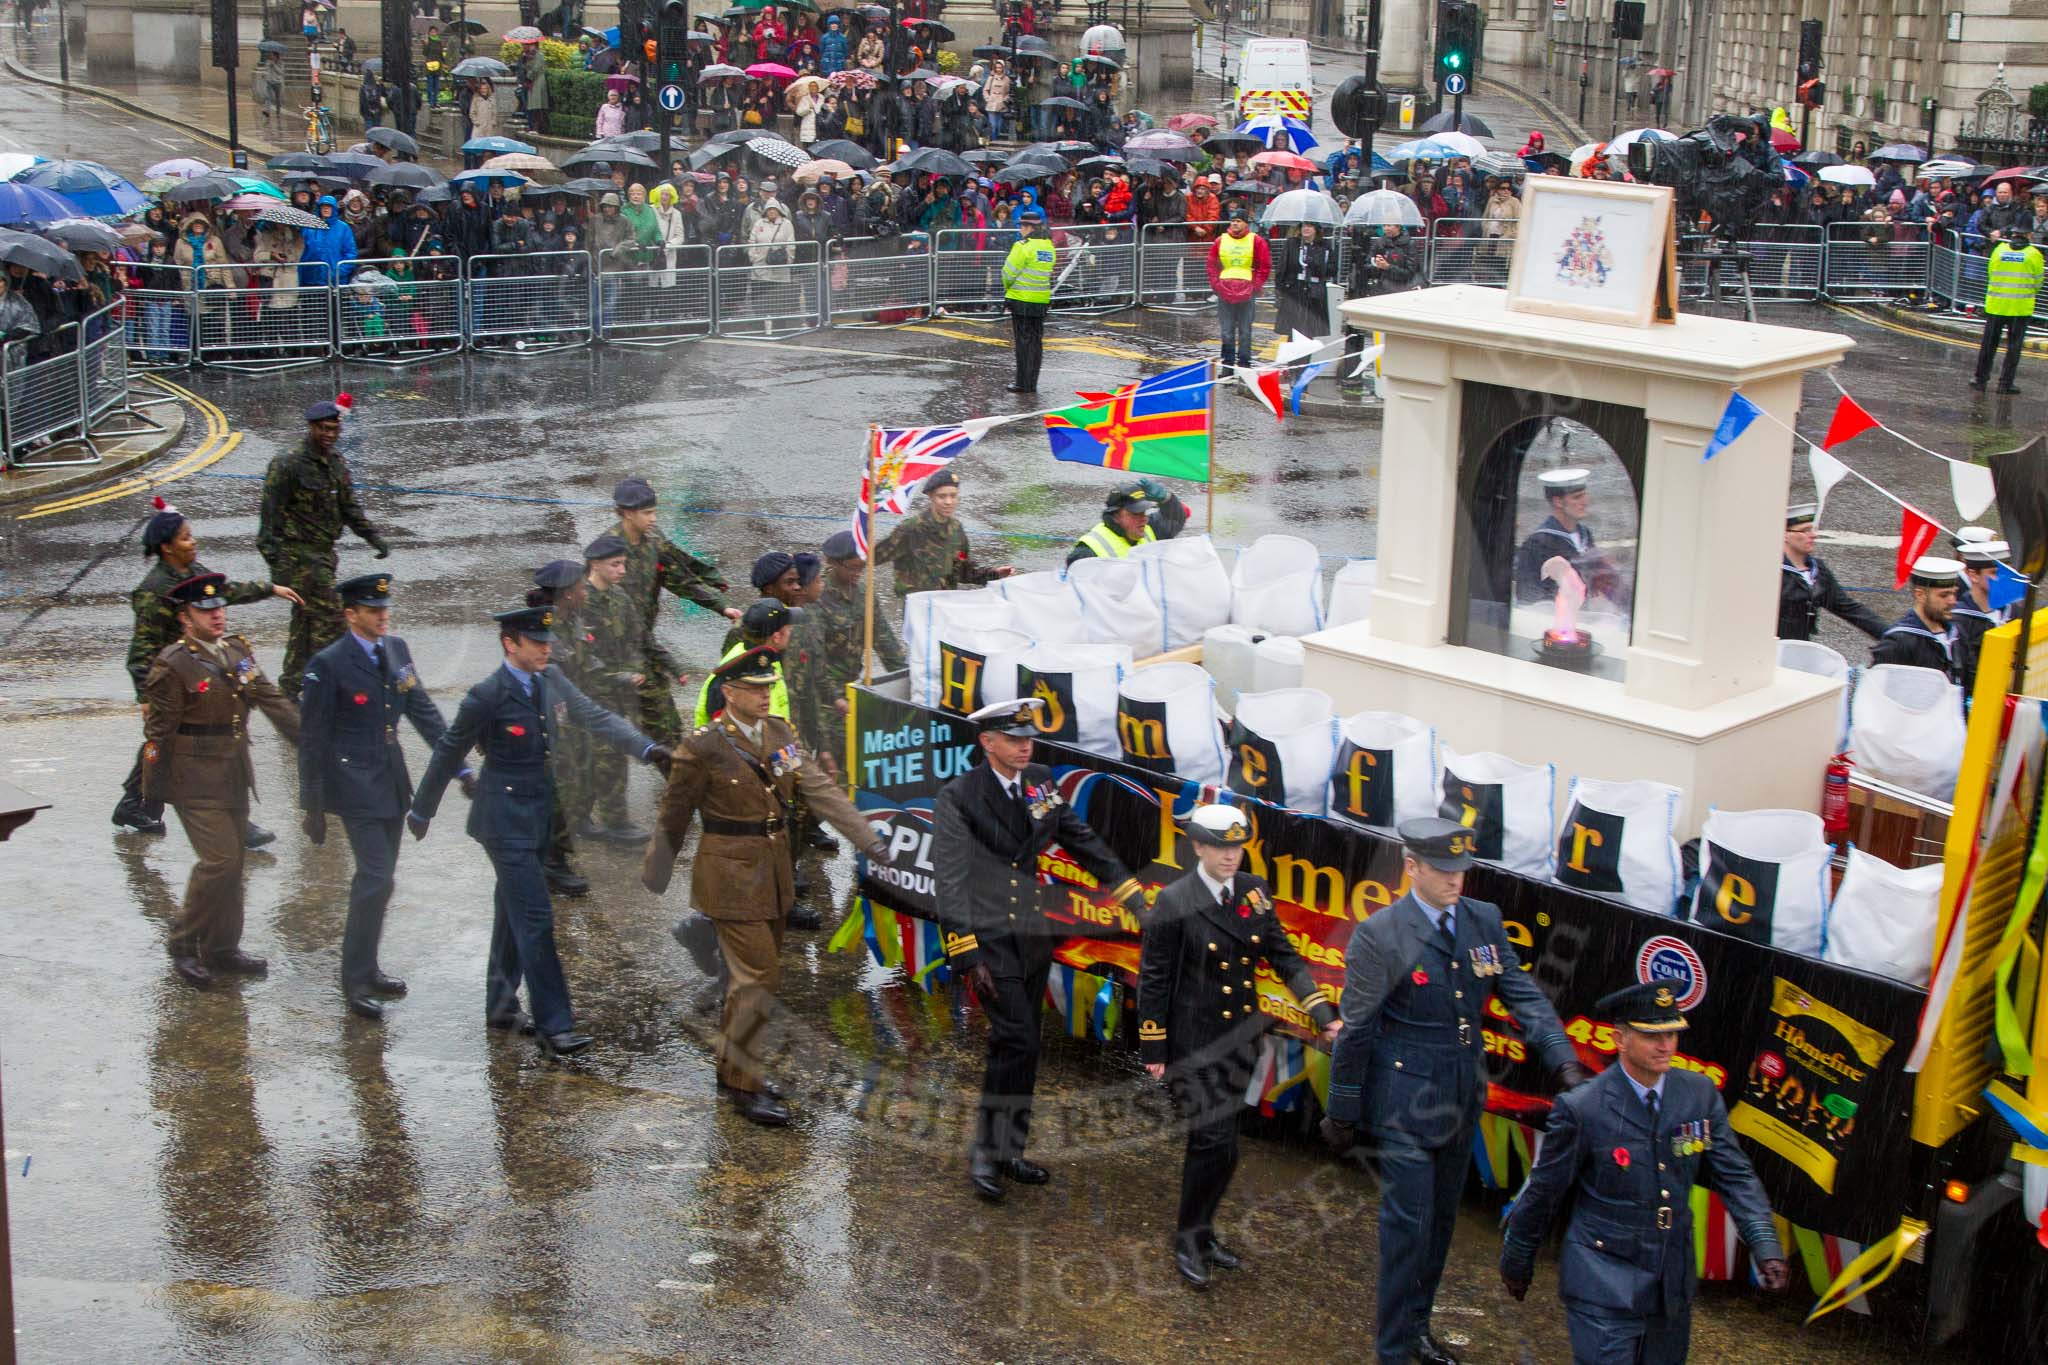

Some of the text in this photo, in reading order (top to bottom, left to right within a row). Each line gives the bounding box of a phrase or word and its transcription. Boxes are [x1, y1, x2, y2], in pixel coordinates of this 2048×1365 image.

[863, 720, 952, 754] Made in
[863, 744, 977, 789] THE UK
[1068, 890, 1114, 925] The
[1651, 961, 1691, 982] COAL
[1565, 1018, 1617, 1051] 45
[1773, 1019, 1868, 1083] Homefire
